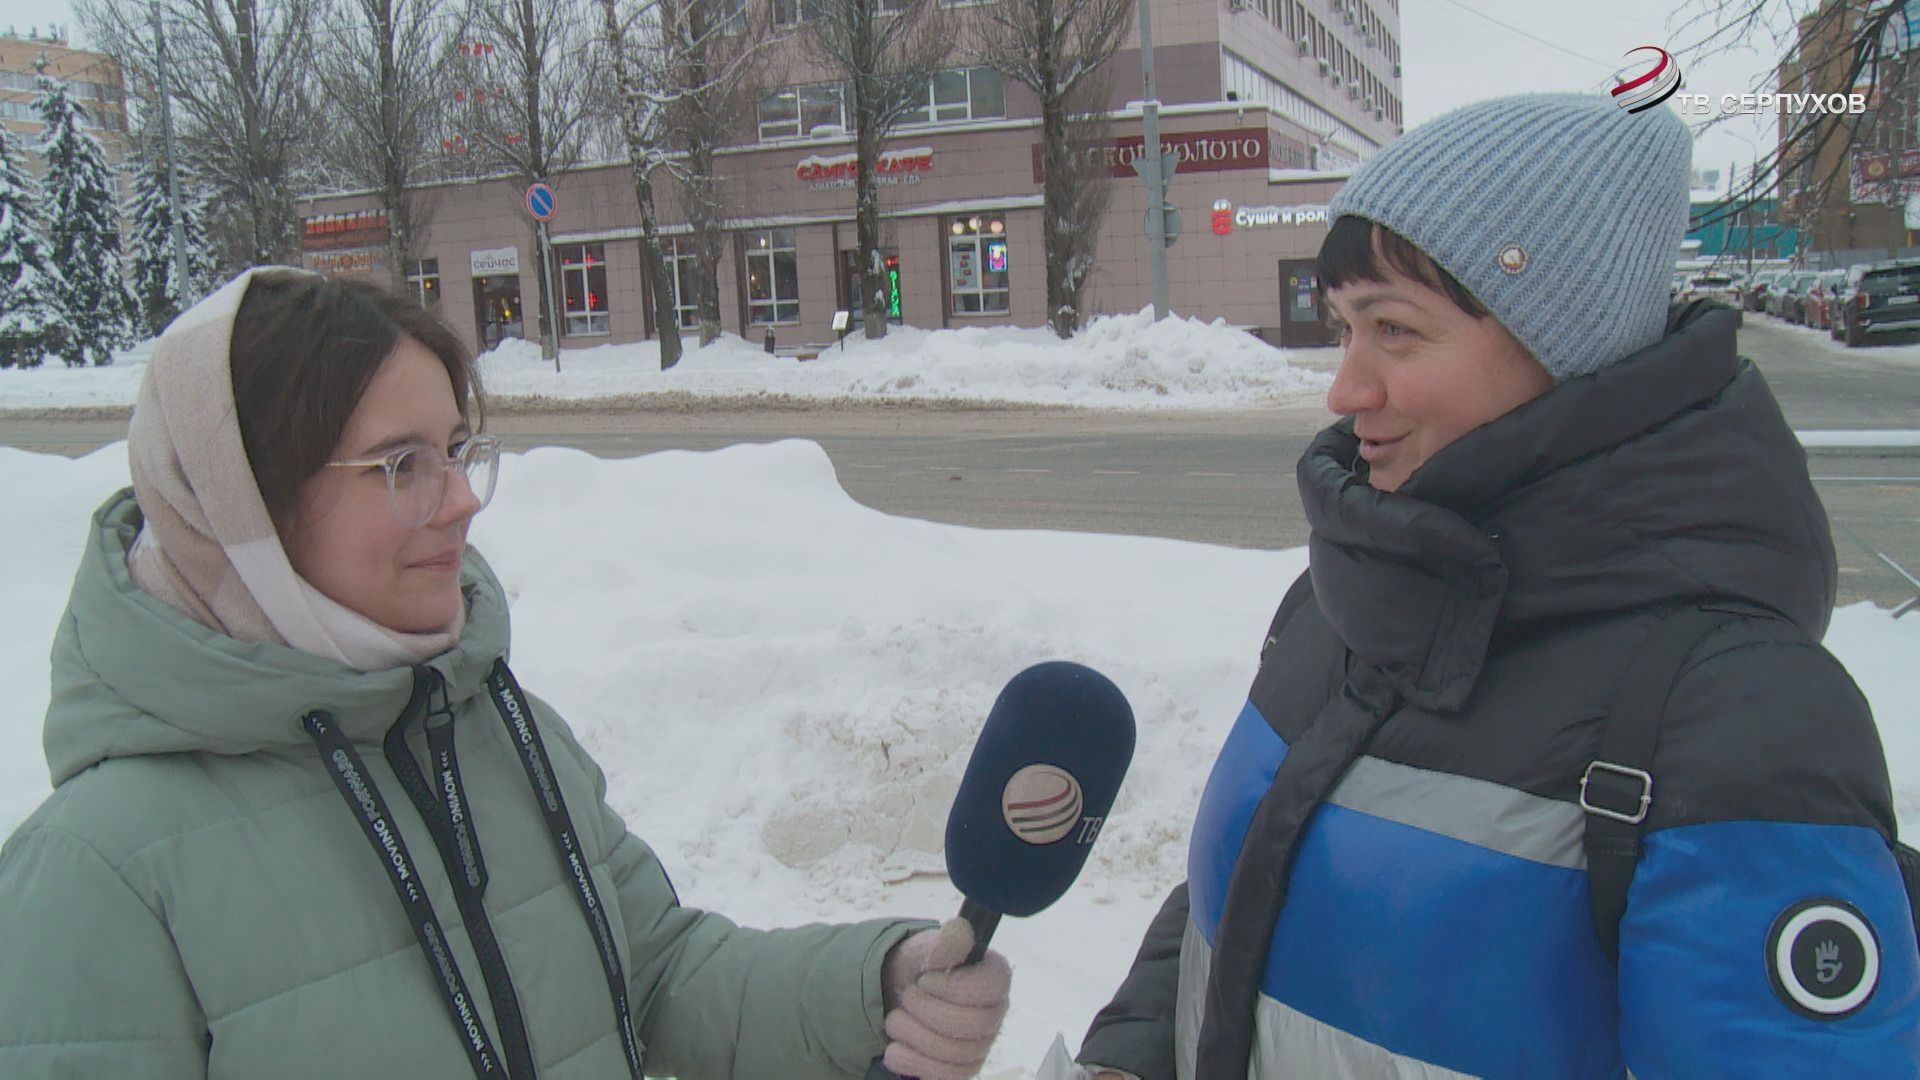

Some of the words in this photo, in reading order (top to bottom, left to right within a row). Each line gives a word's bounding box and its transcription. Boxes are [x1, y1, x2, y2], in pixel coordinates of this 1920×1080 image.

[797, 157, 858, 181] САЙГО
[1235, 210, 1278, 227] Суши
[1282, 212, 1292, 224] и
[1296, 209, 1328, 227] рол
[500, 688, 532, 744] MOVING
[524, 741, 558, 813] FORWARD
[332, 749, 378, 823] FORWARD
[442, 771, 463, 824] MOVING
[373, 817, 409, 881] MOVING
[568, 852, 596, 909] MOVING
[453, 992, 486, 1052] MOVING
